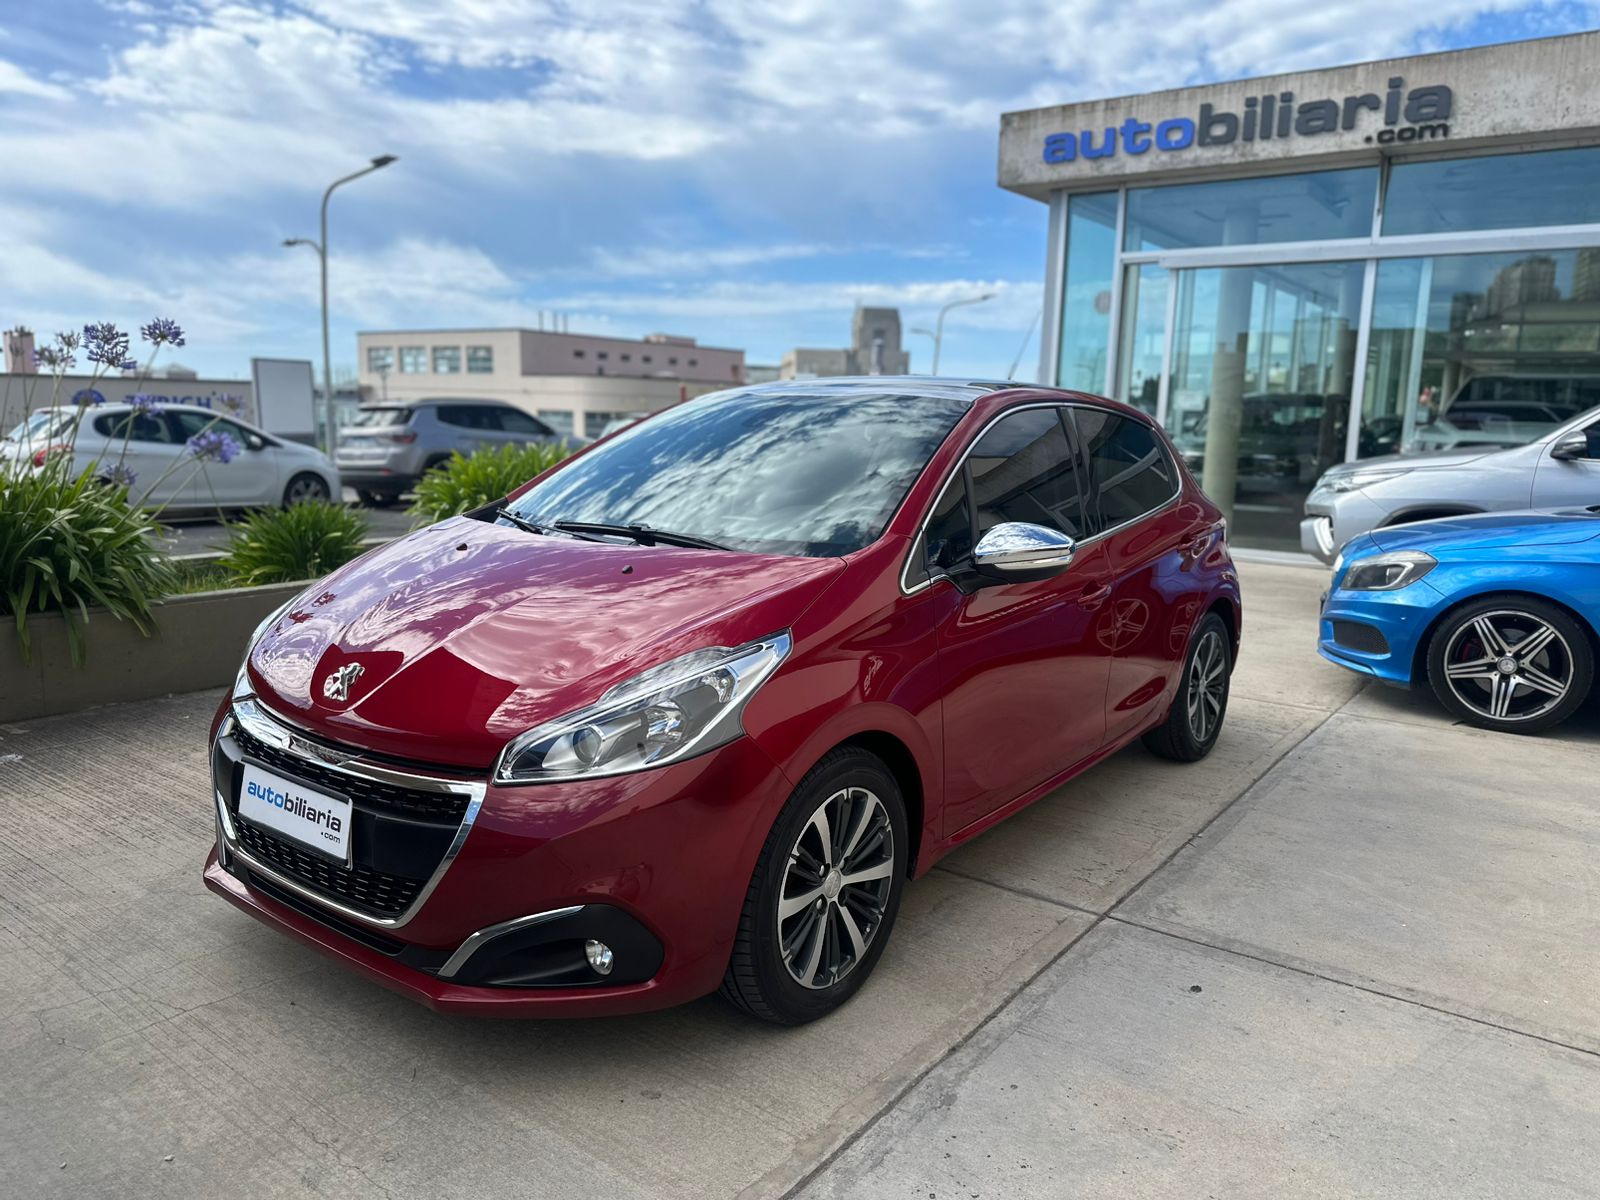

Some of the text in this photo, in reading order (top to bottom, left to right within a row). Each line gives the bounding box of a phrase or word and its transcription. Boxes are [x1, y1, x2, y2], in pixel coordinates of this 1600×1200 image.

[1043, 76, 1452, 165] autobiliaria
[1364, 123, 1450, 145] .com
[247, 780, 342, 833] autobiliaria
[320, 831, 341, 845] .com
